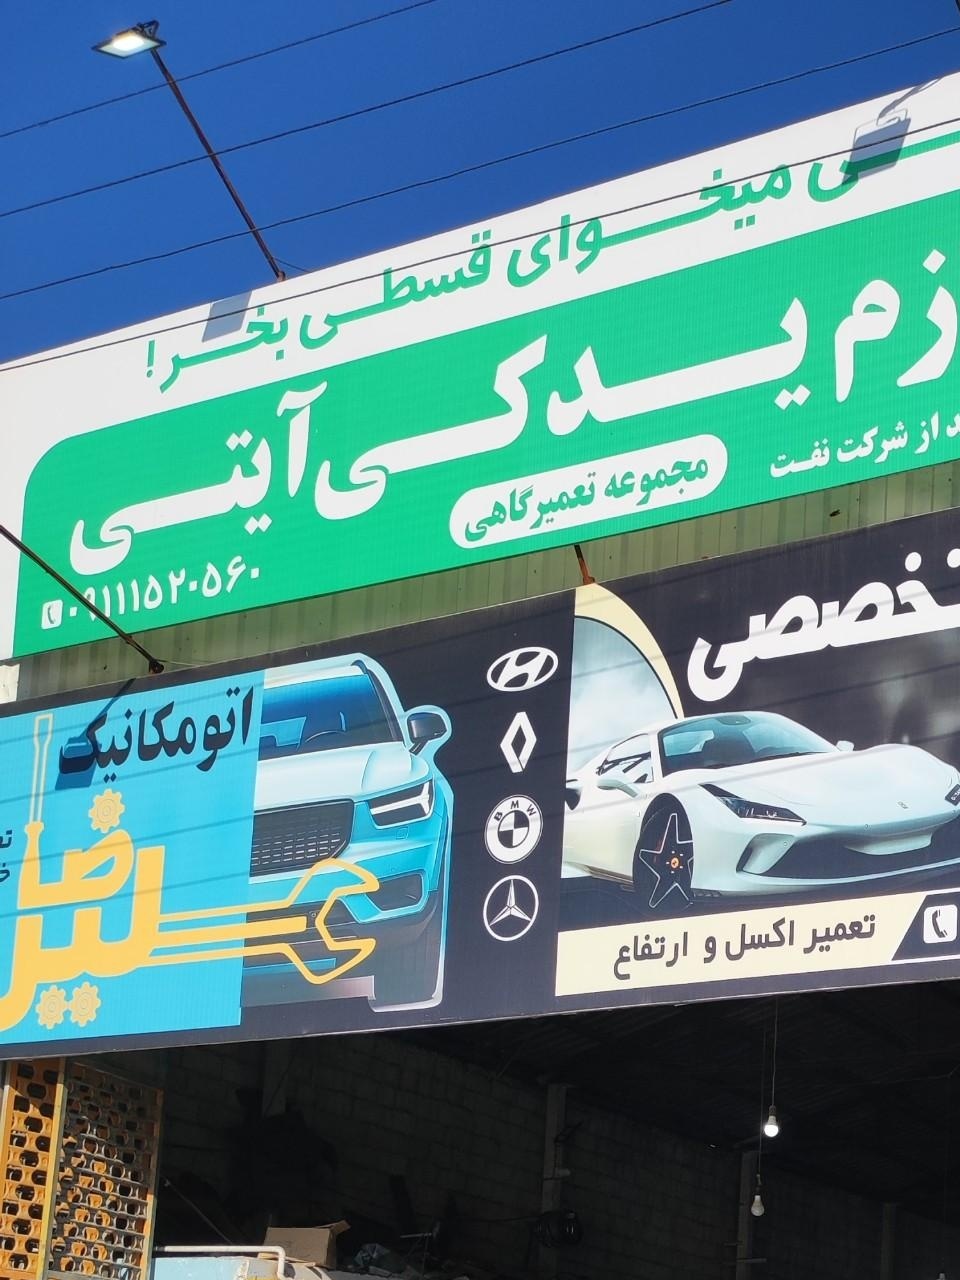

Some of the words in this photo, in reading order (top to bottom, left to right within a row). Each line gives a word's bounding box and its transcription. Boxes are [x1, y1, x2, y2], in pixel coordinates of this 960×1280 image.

[300, 229, 491, 350] قسطی
[314, 299, 811, 519] یدکی
[914, 411, 939, 454] از
[770, 438, 830, 478] نفت
[837, 420, 908, 463] شرکت
[69, 381, 327, 575] آیتی
[604, 458, 708, 506] مجموعه
[464, 471, 596, 541] تعمیرگاهی
[59, 686, 253, 784] اتومکانیک
[613, 931, 688, 980] ارتفاع
[704, 935, 717, 963] و
[725, 917, 795, 961] اکسل
[803, 914, 875, 954] تعمیر
